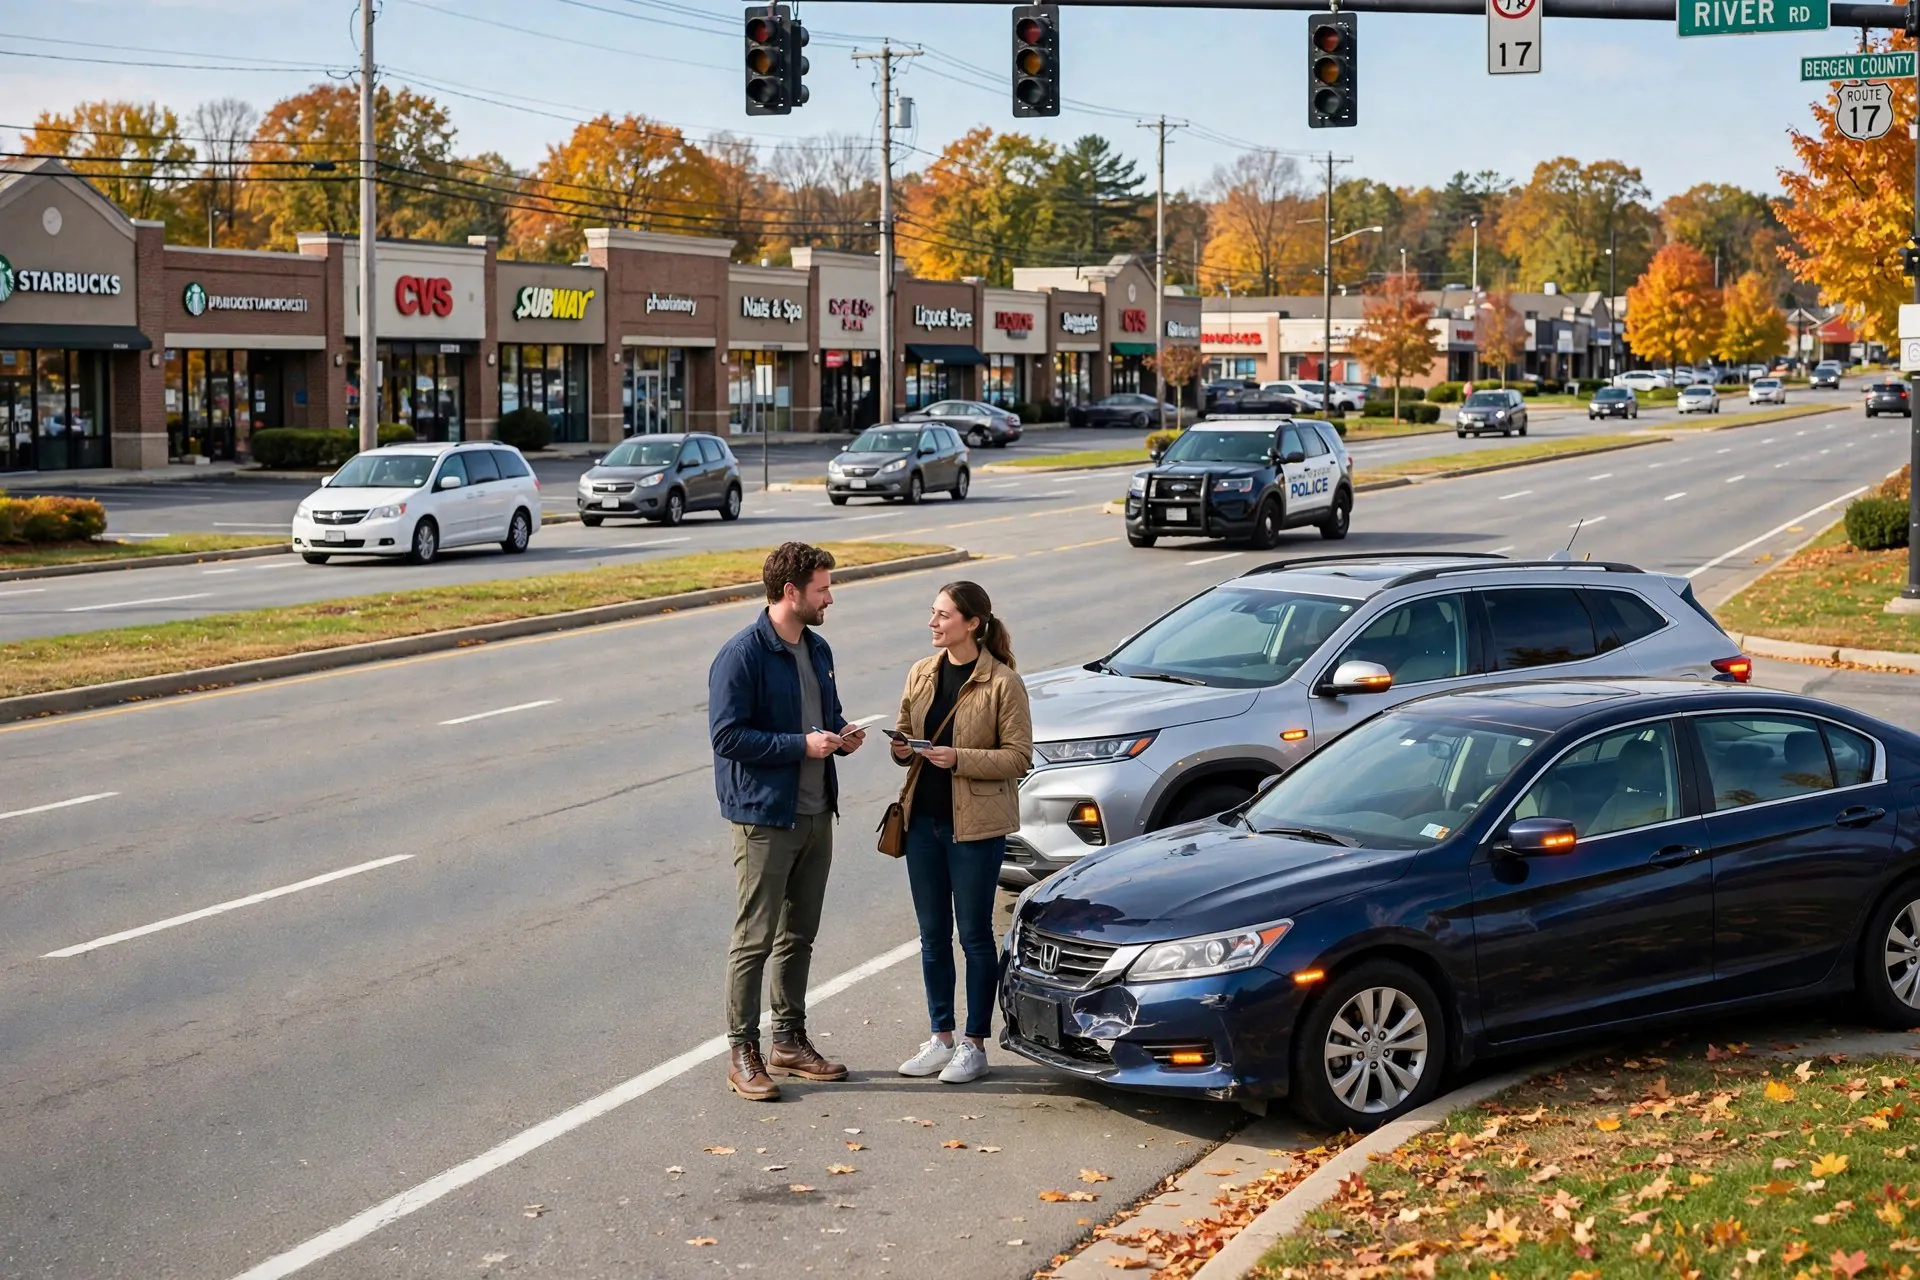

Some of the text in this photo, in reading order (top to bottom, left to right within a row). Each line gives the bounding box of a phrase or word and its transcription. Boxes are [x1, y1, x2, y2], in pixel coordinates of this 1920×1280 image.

[1694, 0, 1811, 27] RIVER RD
[1499, 41, 1532, 67] 17
[1804, 54, 1912, 78] BERGEN COUNTY
[1847, 87, 1882, 102] ROUTE
[1848, 104, 1881, 134] 17
[18, 269, 122, 296] STARBUCKS
[395, 275, 454, 318] CVS
[515, 286, 595, 320] SUBWAY
[783, 298, 803, 324] Spa
[1290, 476, 1329, 500] POLICE
